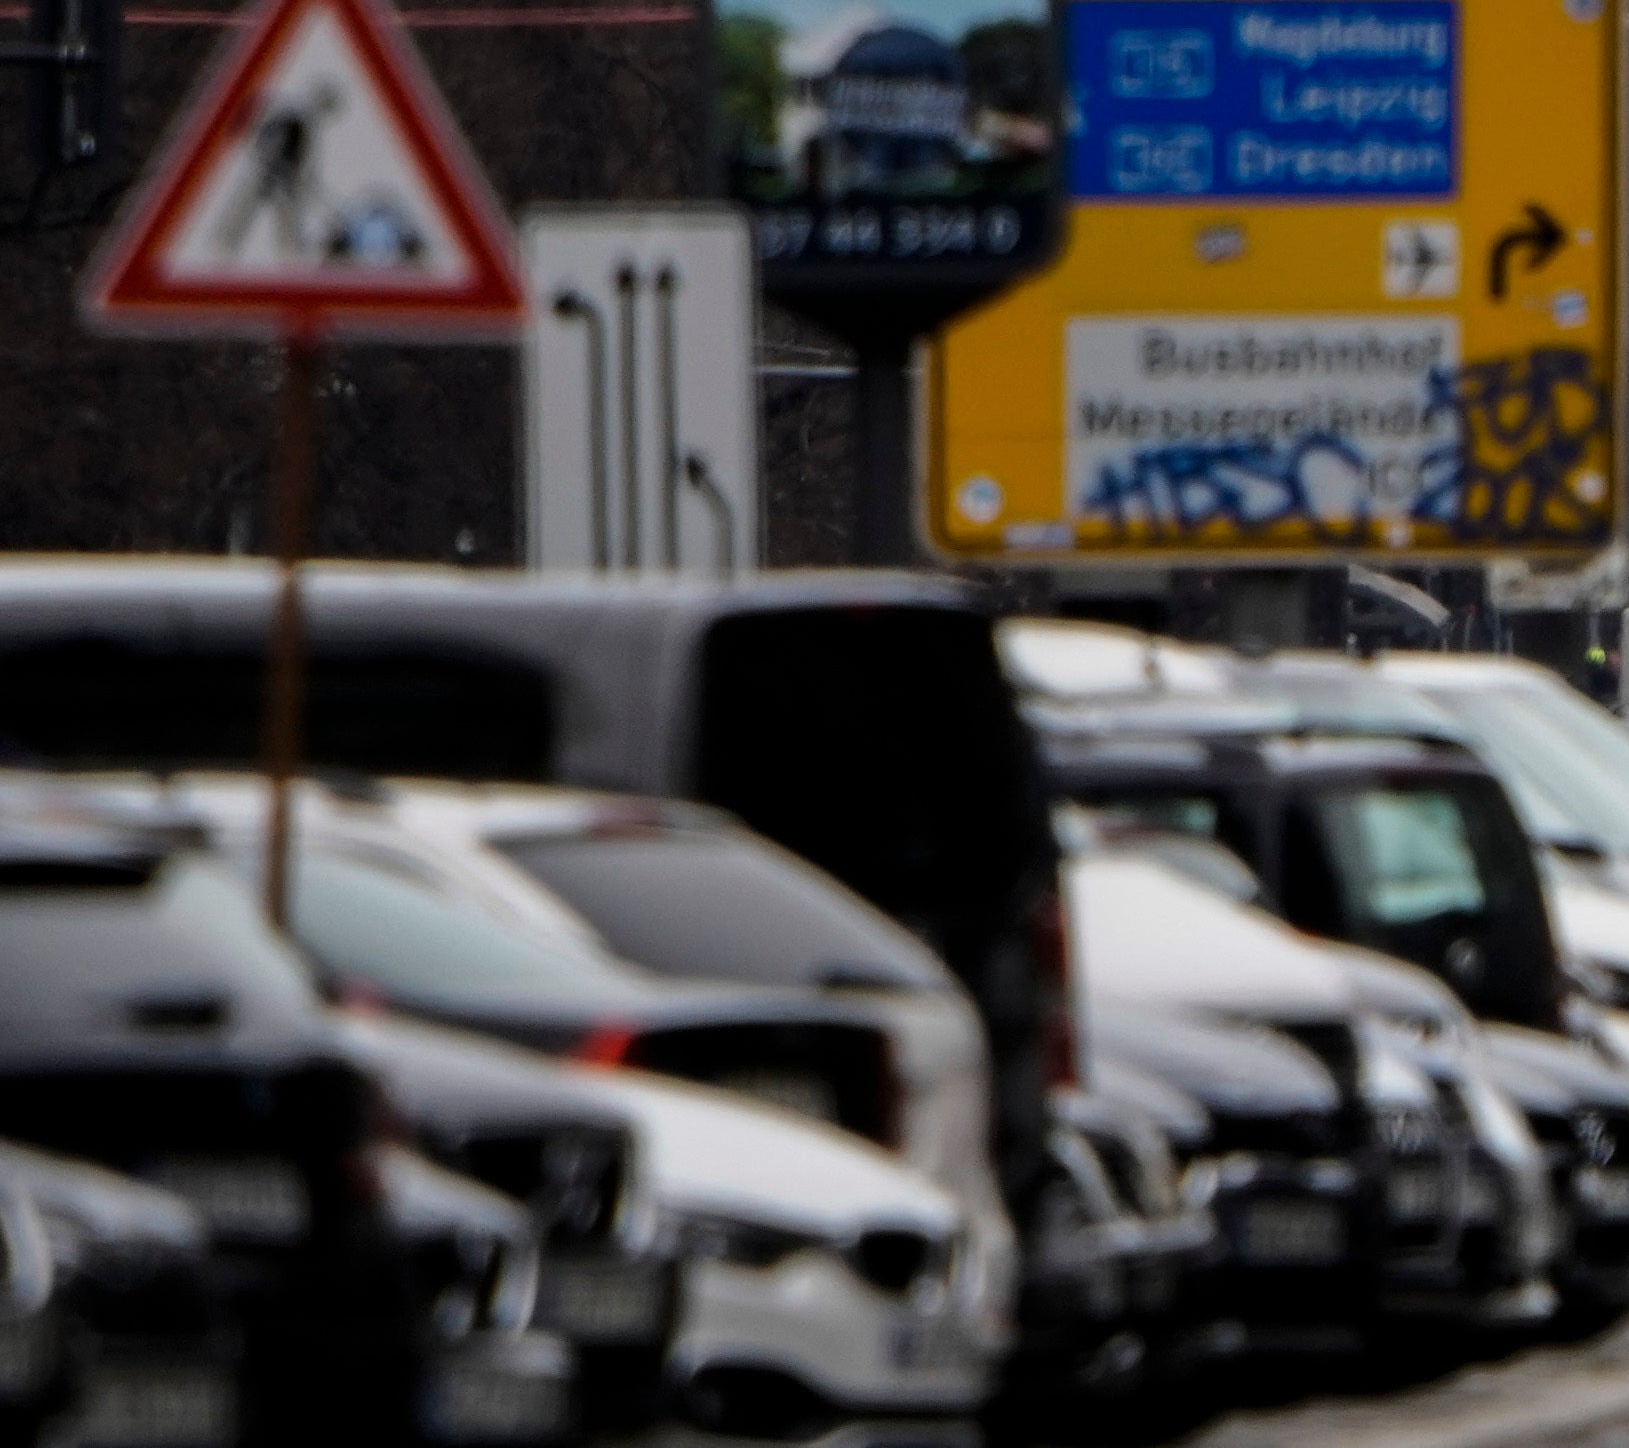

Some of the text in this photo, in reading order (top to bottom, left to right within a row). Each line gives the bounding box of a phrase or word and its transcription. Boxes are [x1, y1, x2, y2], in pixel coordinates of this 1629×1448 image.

[1260, 70, 1449, 131] Leipzig
[1230, 132, 1449, 183] Dresden
[1140, 326, 1443, 381] Busbahnhof
